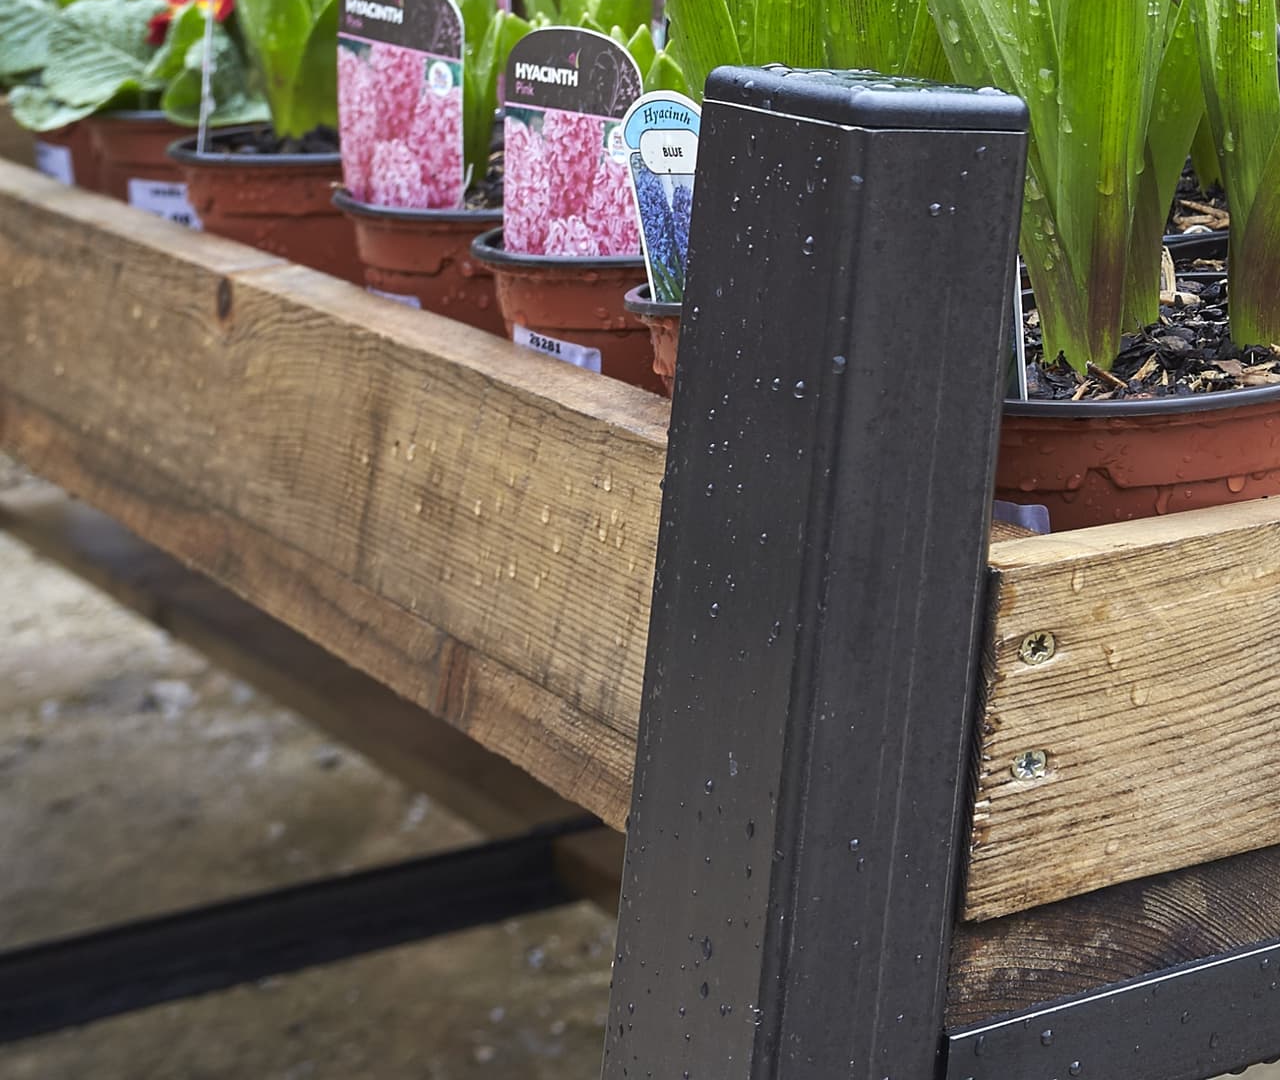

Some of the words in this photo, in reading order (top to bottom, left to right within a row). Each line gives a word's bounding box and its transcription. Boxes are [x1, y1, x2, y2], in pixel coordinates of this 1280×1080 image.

[515, 62, 579, 88] HYACINTH
[643, 106, 691, 125] Hyacinth
[662, 146, 684, 158] BLUE
[529, 332, 561, 354] 25281
